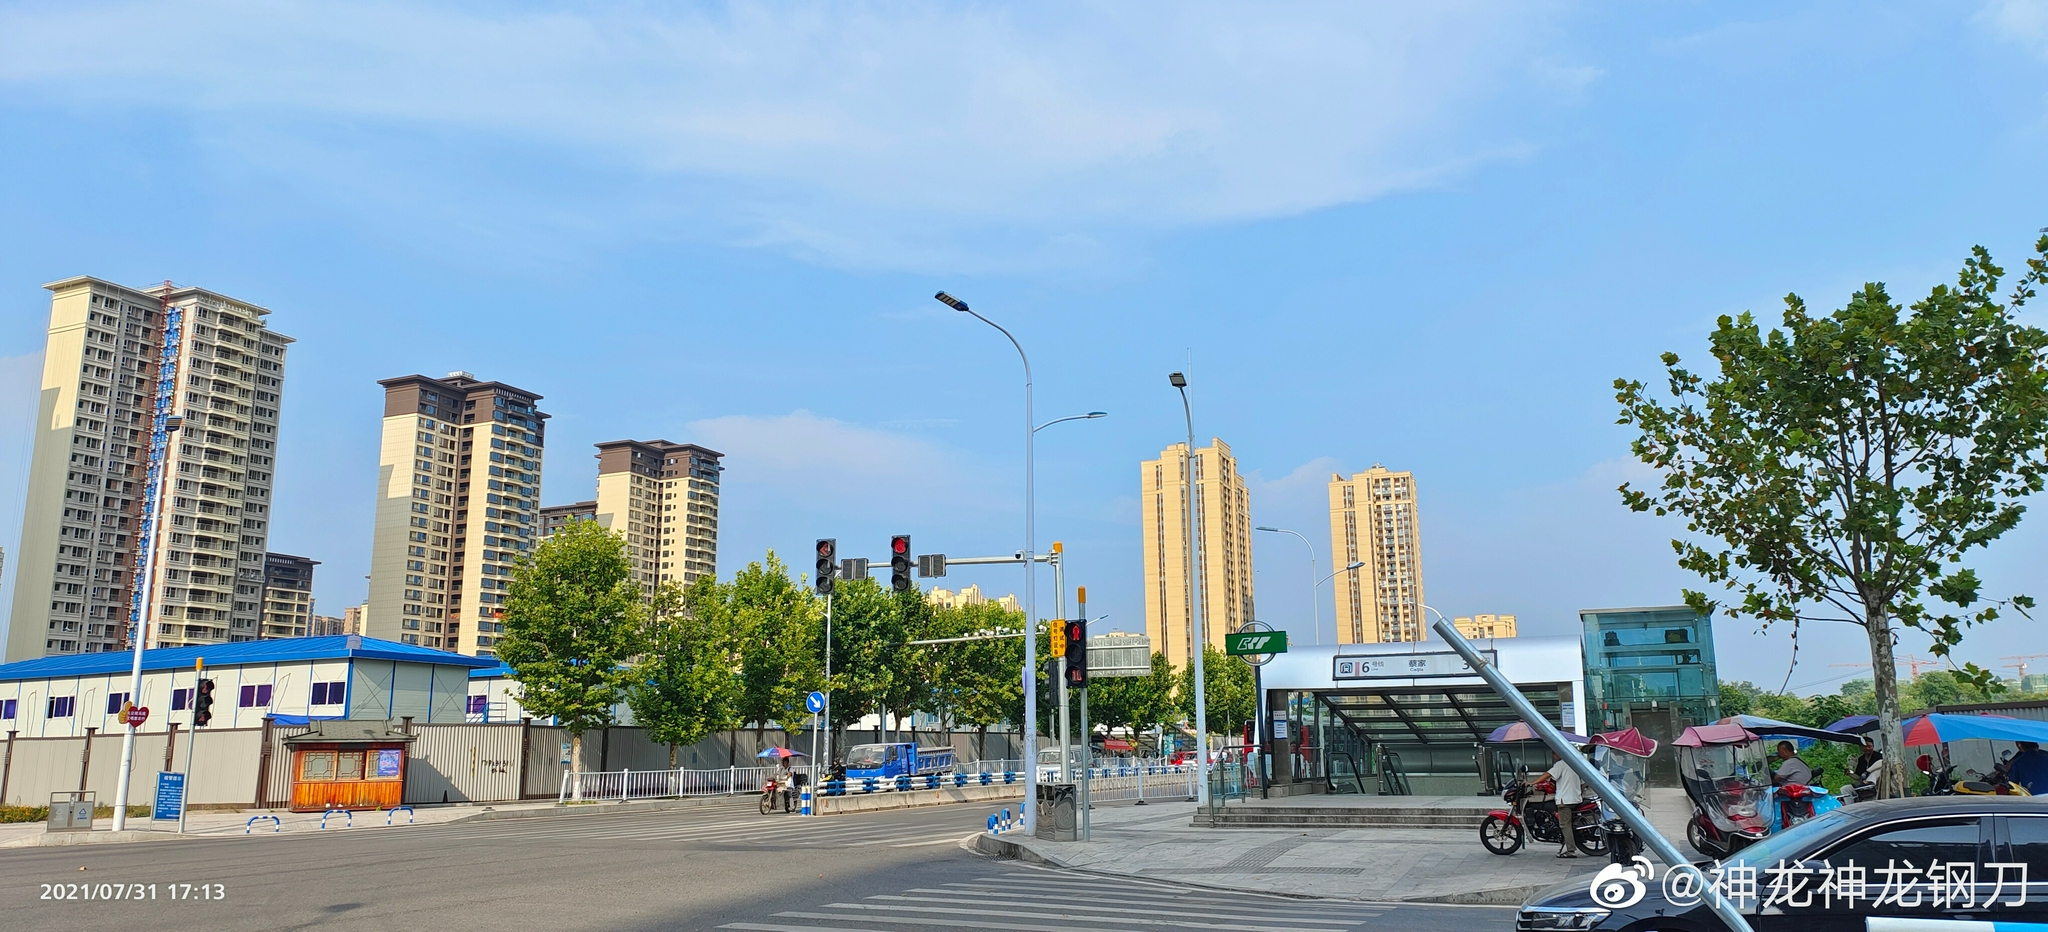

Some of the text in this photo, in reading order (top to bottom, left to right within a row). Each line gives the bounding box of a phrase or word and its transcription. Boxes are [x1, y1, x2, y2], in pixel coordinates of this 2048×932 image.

[1361, 660, 1385, 673] 6 号线
[1408, 659, 1427, 668] 蔡家
